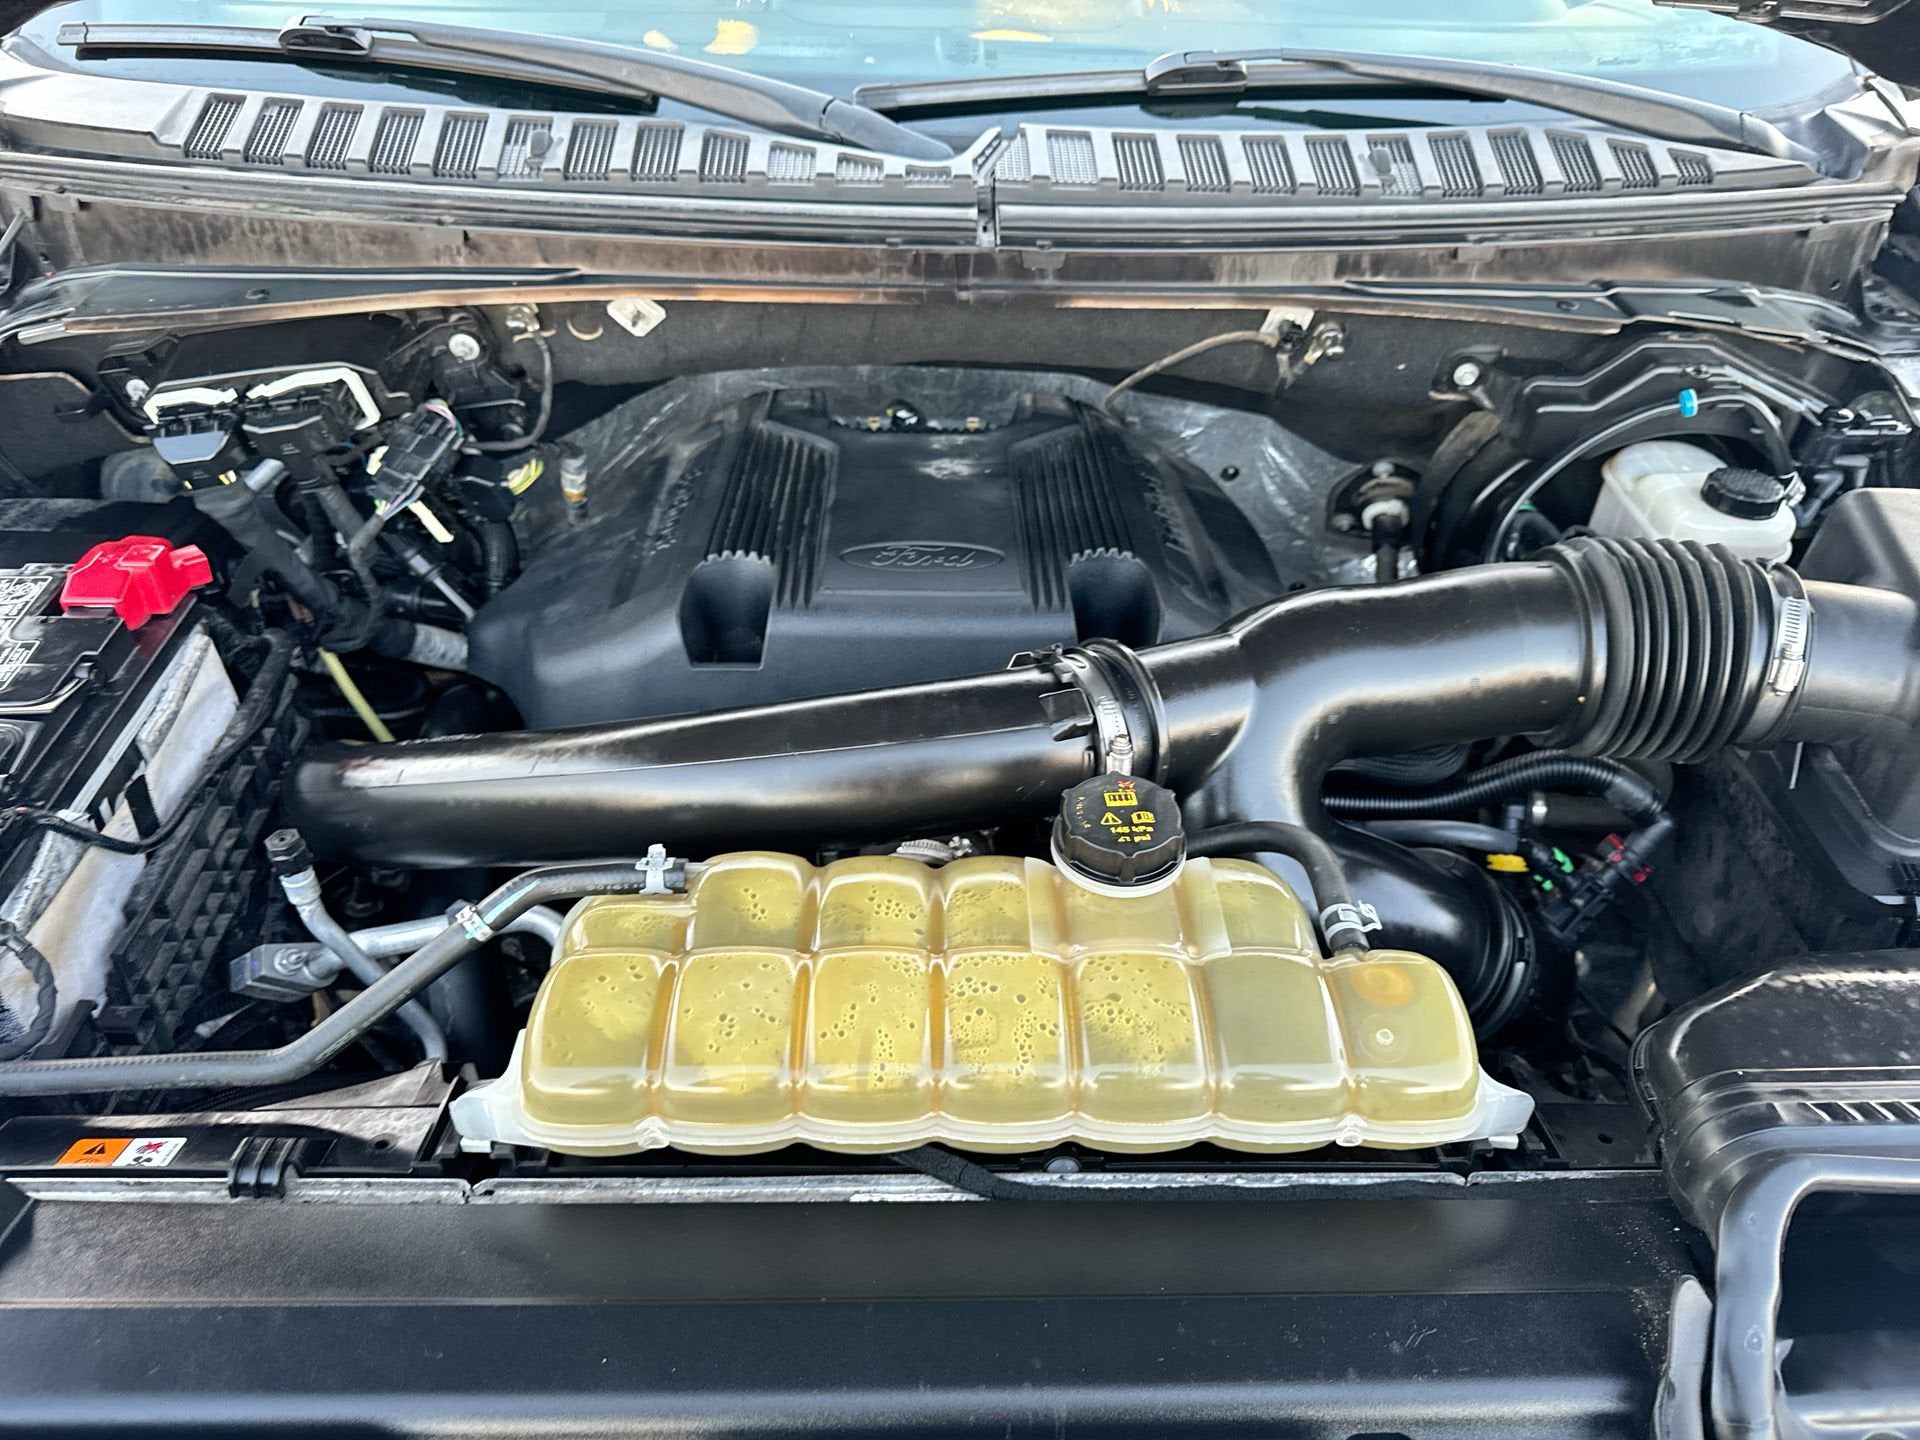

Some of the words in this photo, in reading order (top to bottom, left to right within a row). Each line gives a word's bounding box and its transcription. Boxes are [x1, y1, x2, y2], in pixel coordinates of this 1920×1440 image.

[870, 545, 976, 567] Ford
[1110, 826, 1130, 834] 145
[1131, 825, 1154, 833] kPa
[1133, 834, 1151, 843] psi
